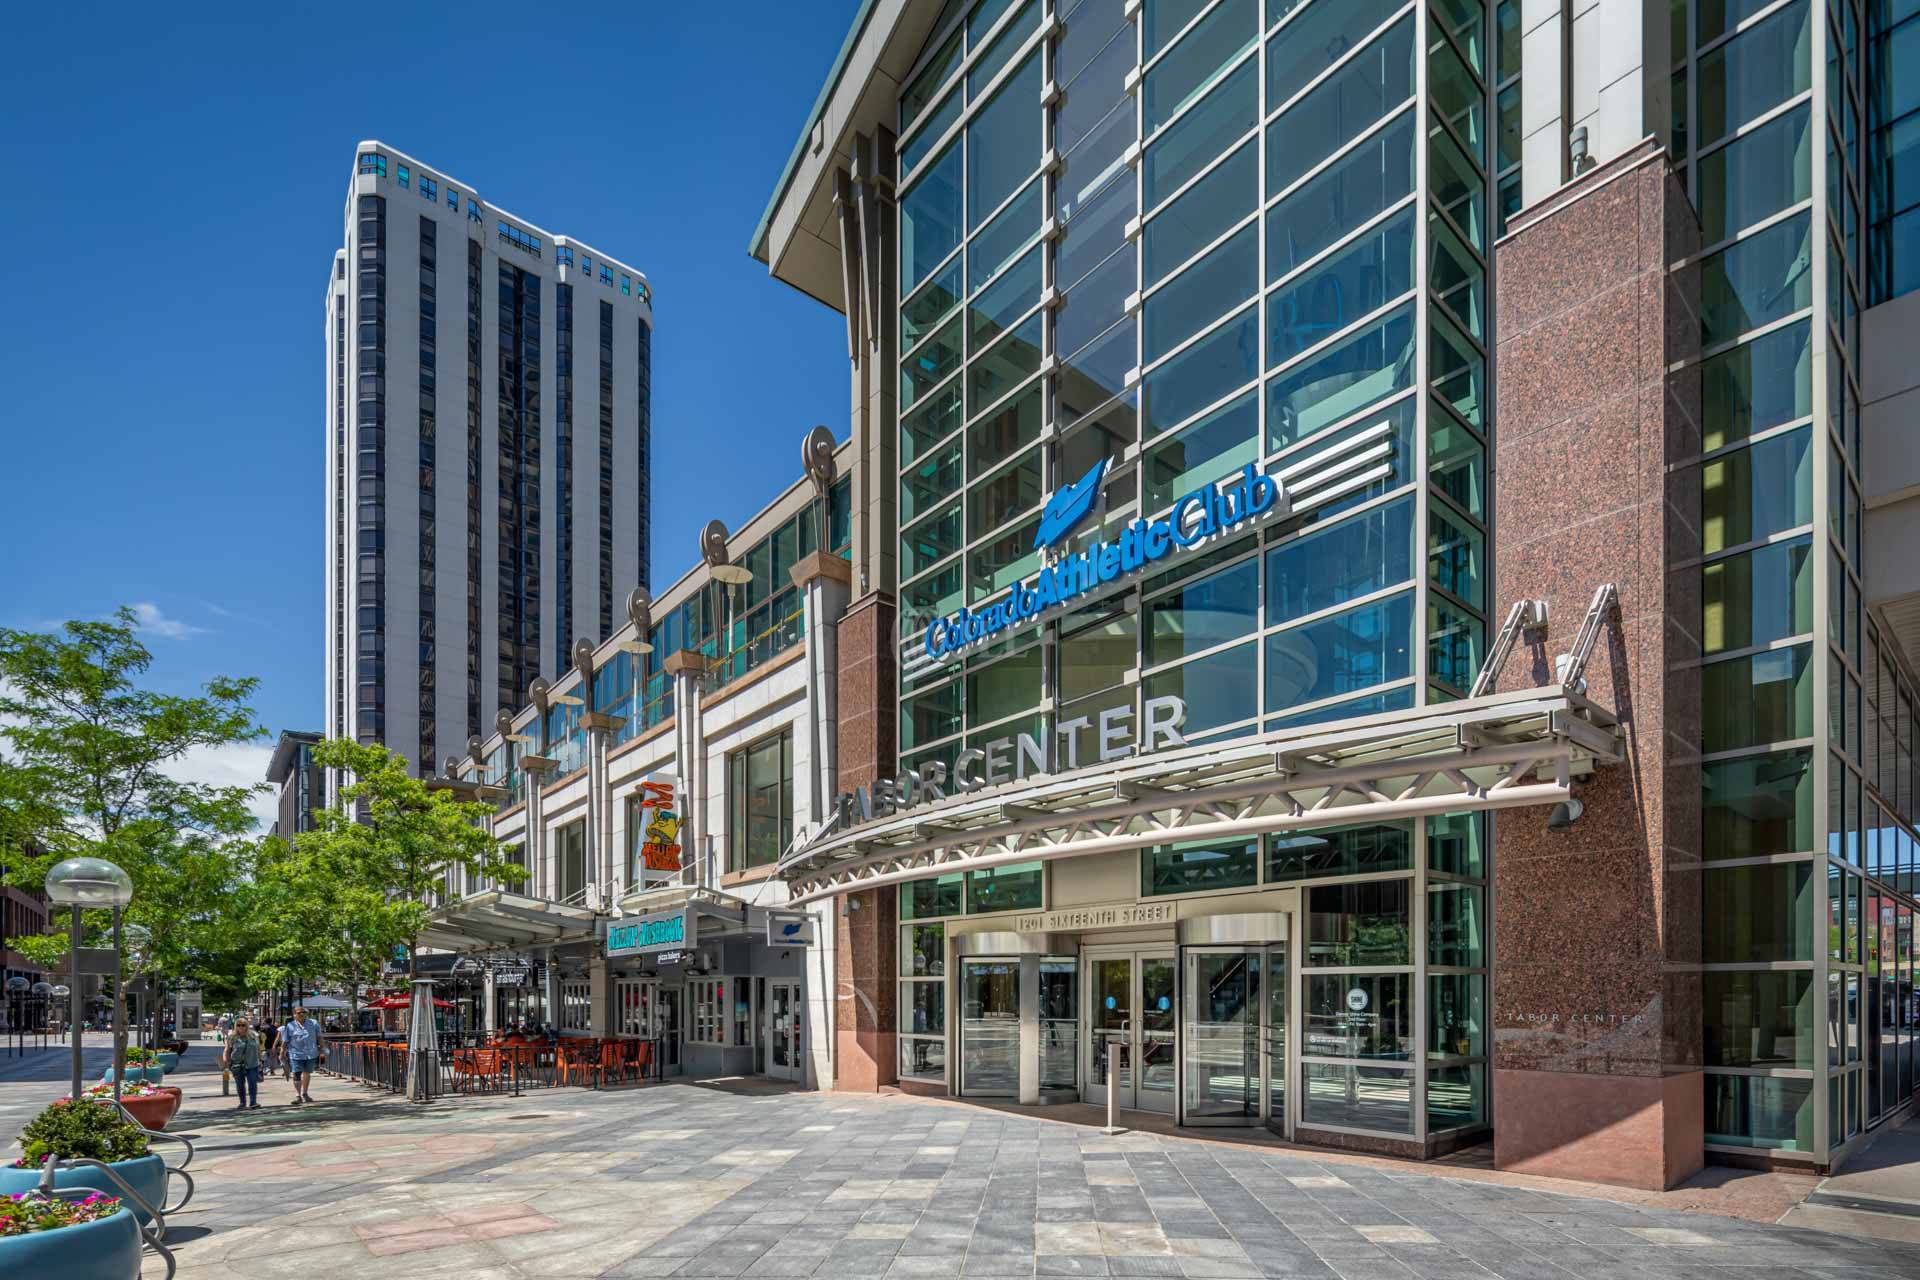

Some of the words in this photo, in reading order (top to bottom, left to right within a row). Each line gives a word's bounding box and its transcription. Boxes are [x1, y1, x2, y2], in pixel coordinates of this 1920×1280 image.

[834, 759, 947, 829] TABOR
[953, 694, 1188, 793] CENTER
[1018, 917, 1043, 931] 1201
[1048, 910, 1116, 929] SIXTEENTH
[1122, 904, 1171, 921] STREET
[1506, 1012, 1560, 1022] TABOR
[1571, 1013, 1644, 1024] CENTER
